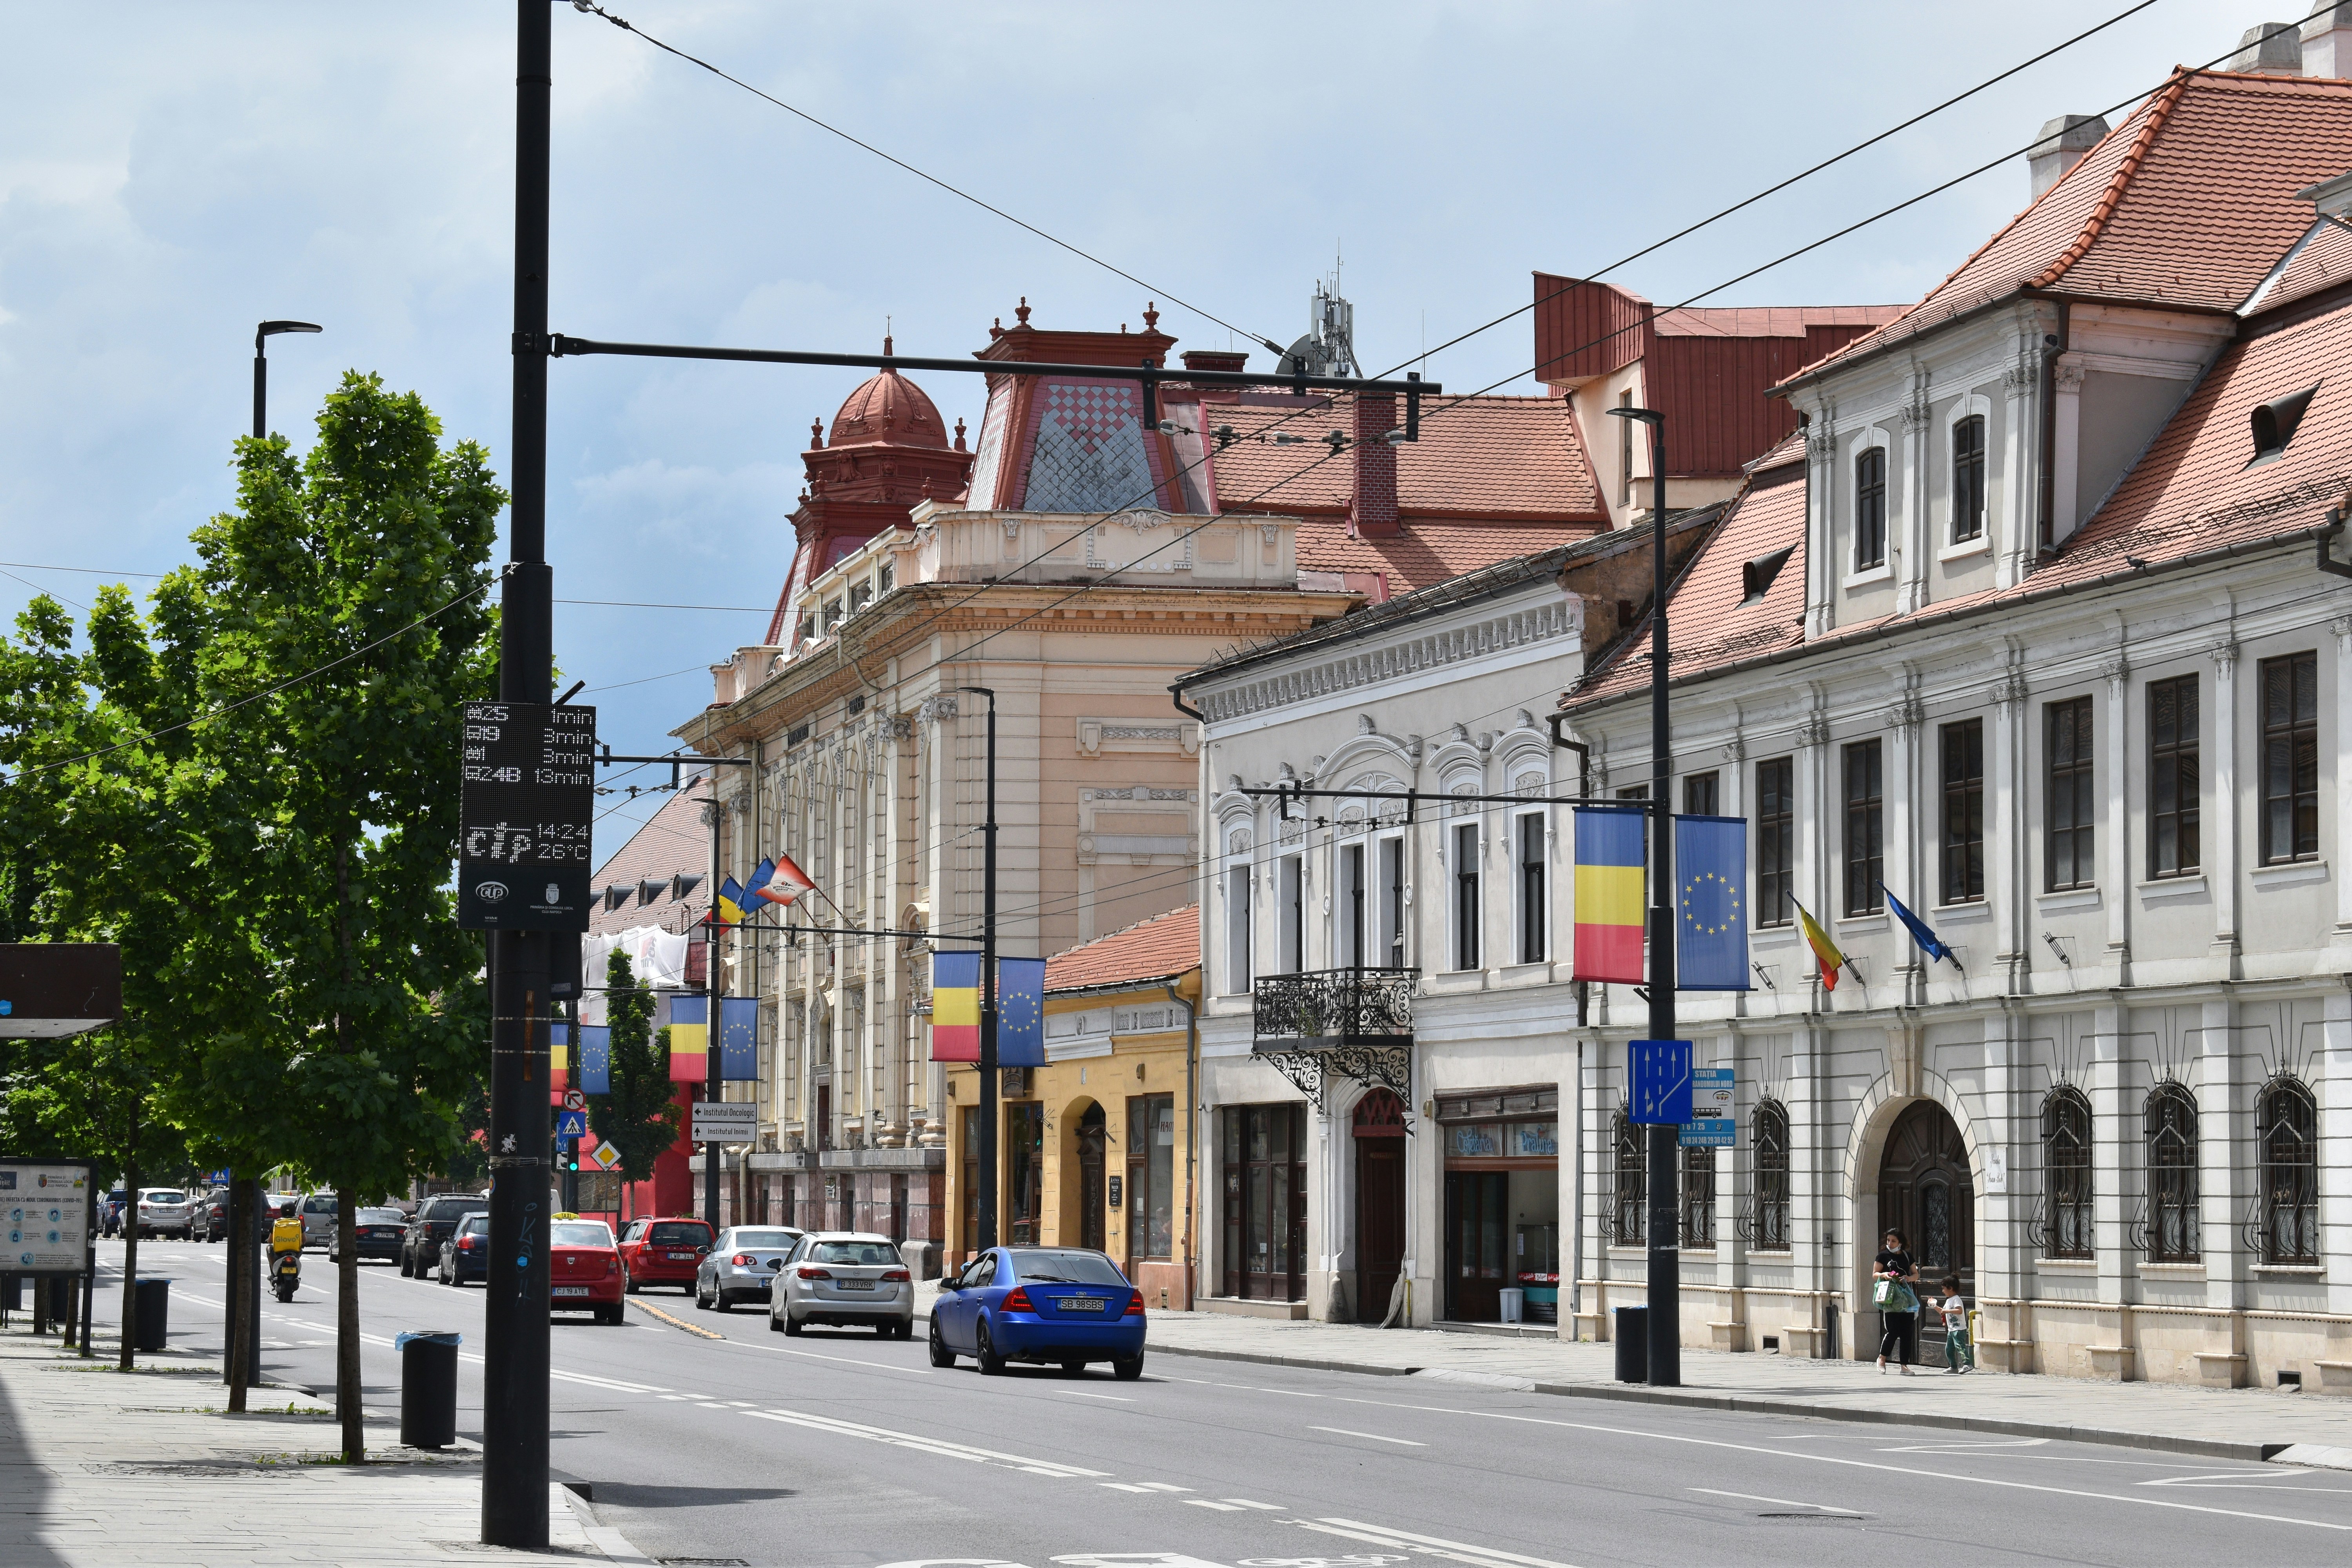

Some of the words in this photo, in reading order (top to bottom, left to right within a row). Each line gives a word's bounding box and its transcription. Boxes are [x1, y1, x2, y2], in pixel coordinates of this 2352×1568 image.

[537, 823, 588, 839] 14:24
[704, 1107, 728, 1116] Institutul
[729, 1108, 755, 1119] Oncologic
